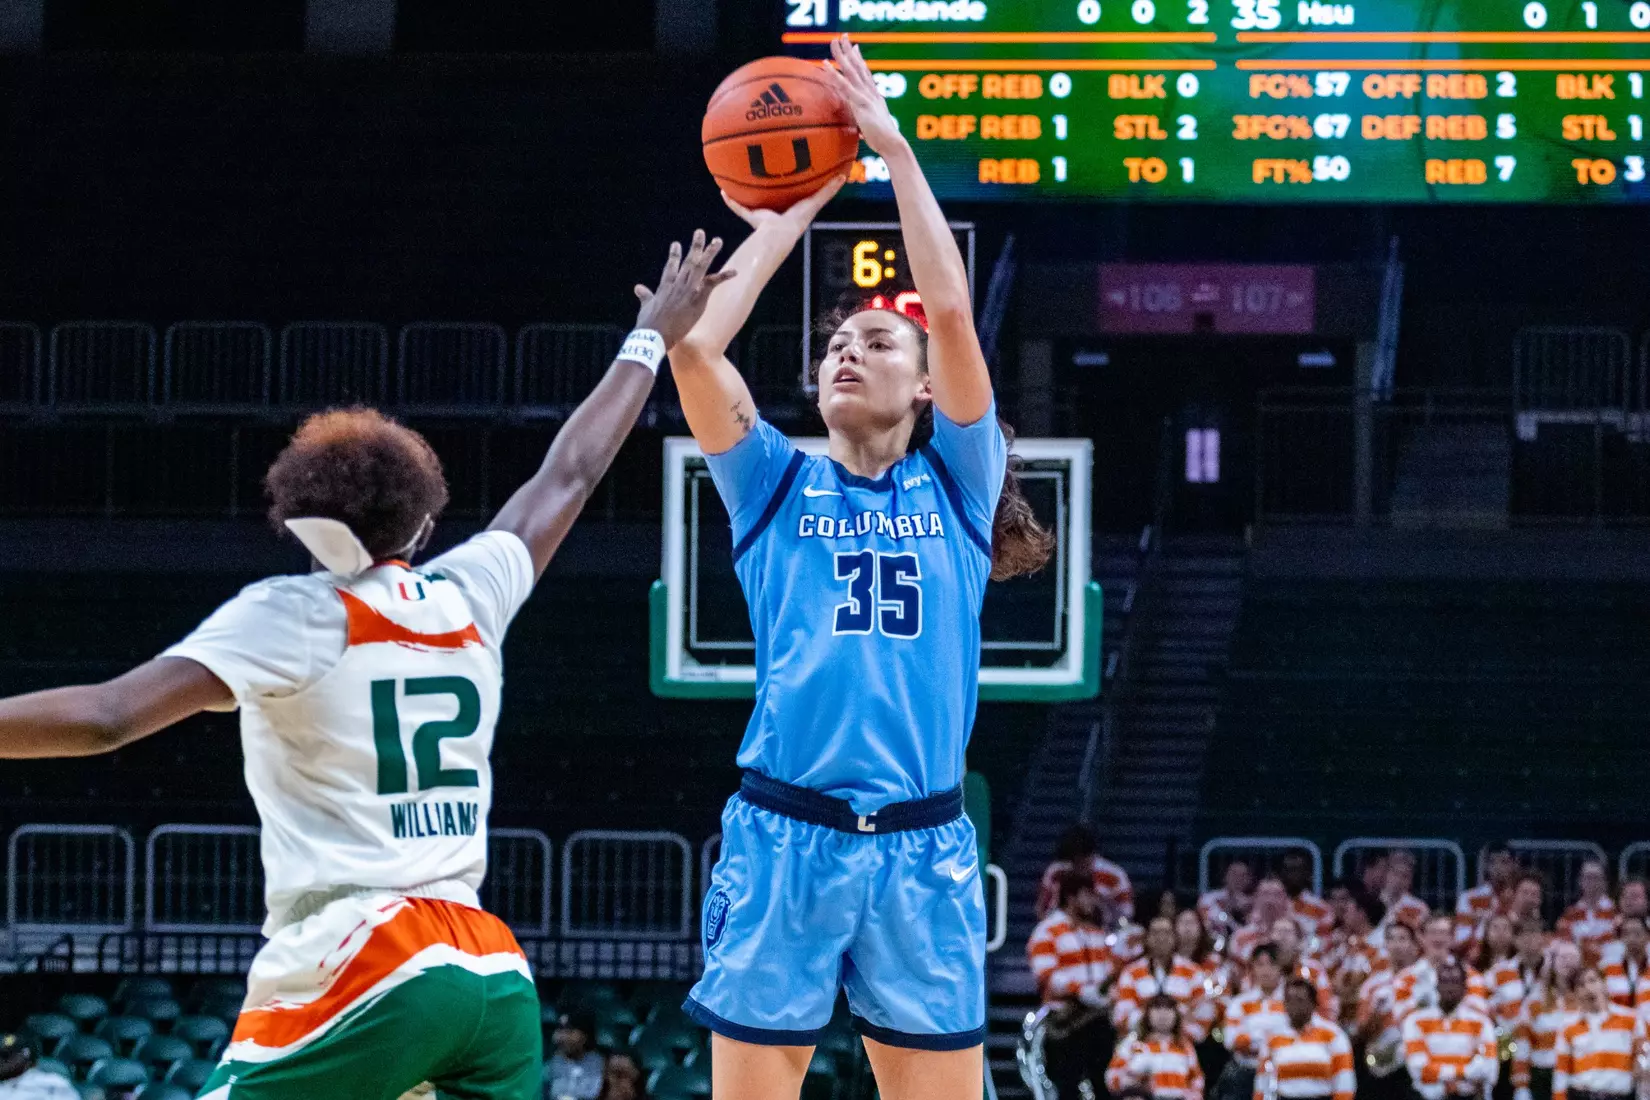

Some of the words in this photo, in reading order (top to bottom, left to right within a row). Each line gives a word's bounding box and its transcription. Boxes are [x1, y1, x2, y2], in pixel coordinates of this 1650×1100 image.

[786, 0, 828, 27] 21
[838, 0, 987, 22] Pendande
[1077, 0, 1101, 25] 0
[1131, 0, 1156, 25] 0
[1186, 0, 1209, 25] 2
[1230, 0, 1282, 30] 35
[1297, 0, 1355, 26] Hsu
[1523, 1, 1547, 29] 0
[1581, 1, 1598, 29] 1
[1629, 1, 1650, 29] 0
[918, 73, 979, 99] OFF
[982, 73, 1043, 99] REB
[1049, 72, 1072, 98] 0
[1107, 73, 1167, 99] BLK
[1176, 72, 1199, 98] 0
[1249, 73, 1314, 99] FG%
[1315, 71, 1351, 97] 57
[1362, 73, 1422, 99] OFF
[1426, 73, 1488, 99] REB
[1495, 71, 1518, 97] 2
[1556, 73, 1616, 99] BLK
[1628, 72, 1643, 98] 1
[745, 103, 803, 122] adidas
[916, 114, 977, 140] DEF
[980, 114, 1042, 140] REB
[1051, 114, 1068, 140] 1
[1113, 114, 1168, 140] STL
[1176, 114, 1198, 140] 2
[1231, 114, 1314, 140] 3FG%
[1313, 113, 1352, 139] 67
[1361, 114, 1422, 140] DEF
[1425, 114, 1488, 140] REB
[1496, 113, 1517, 139] 5
[1562, 114, 1617, 140] STL
[1627, 114, 1643, 140] 1
[747, 136, 811, 179] U
[978, 158, 1040, 184] REB
[1051, 155, 1067, 182] 1
[1123, 157, 1168, 183] TO
[1179, 156, 1195, 183] 1
[1252, 158, 1313, 184] FT%
[1312, 155, 1351, 181] 50
[1425, 158, 1488, 184] REB
[1494, 155, 1517, 182] 7
[1571, 158, 1616, 185] TO
[1623, 155, 1646, 182] 3
[799, 511, 945, 540] COLUMBIA
[398, 581, 426, 602] U
[832, 549, 923, 640] 35
[371, 675, 481, 795] 12
[390, 801, 478, 838] WILLIAMS
